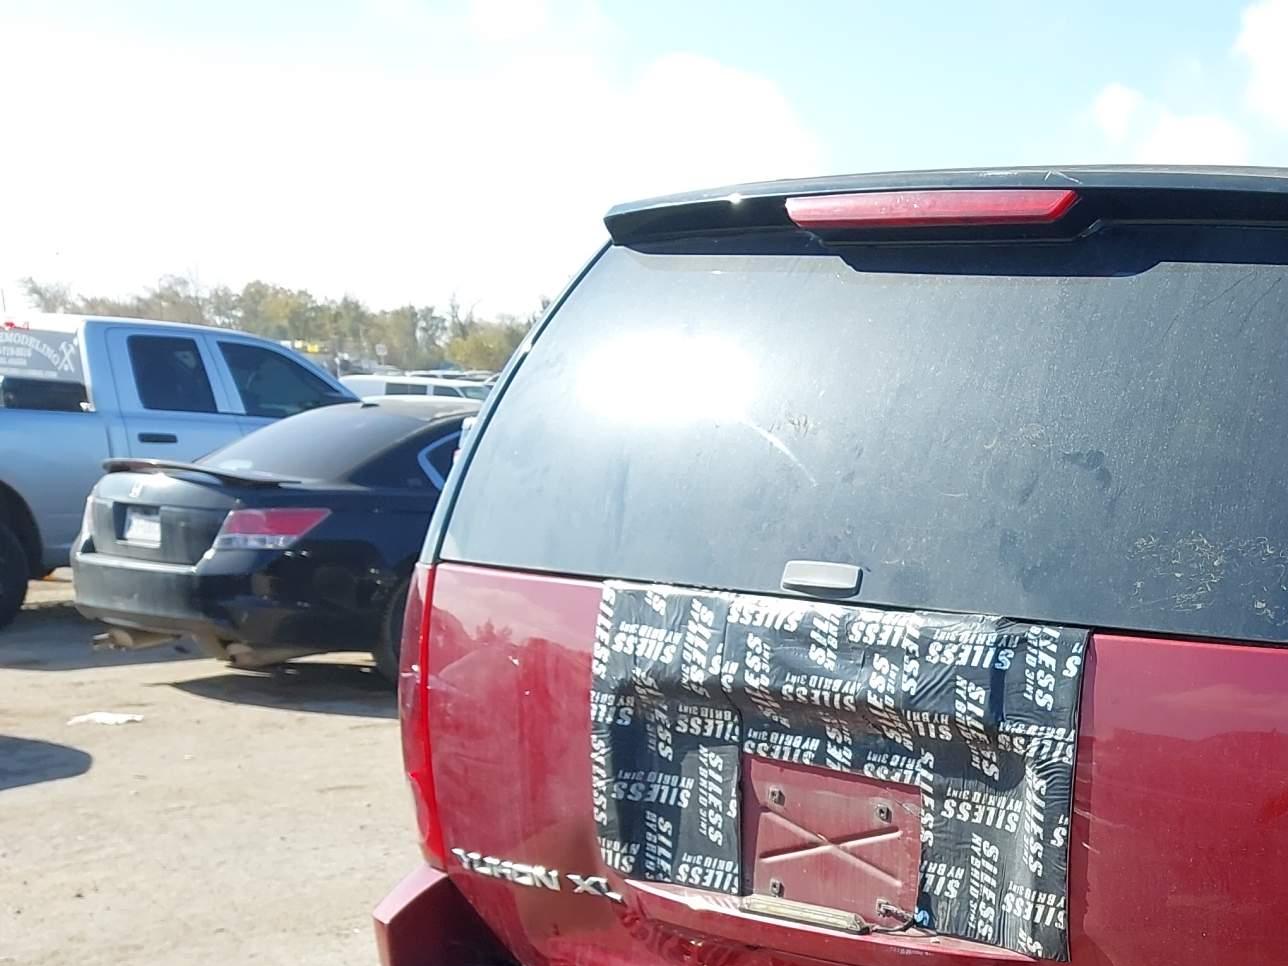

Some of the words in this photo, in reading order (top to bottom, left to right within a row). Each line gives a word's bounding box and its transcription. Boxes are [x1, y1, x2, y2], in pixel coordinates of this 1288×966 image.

[610, 633, 677, 665] SILESS
[925, 641, 1016, 671] SILESS
[781, 683, 857, 713] SILESS
[611, 781, 692, 809] SILESS
[708, 752, 724, 847] SILESS
[940, 799, 1020, 833] SILESS
[976, 840, 1000, 941] SILESS
[1001, 892, 1066, 930] SILESS
